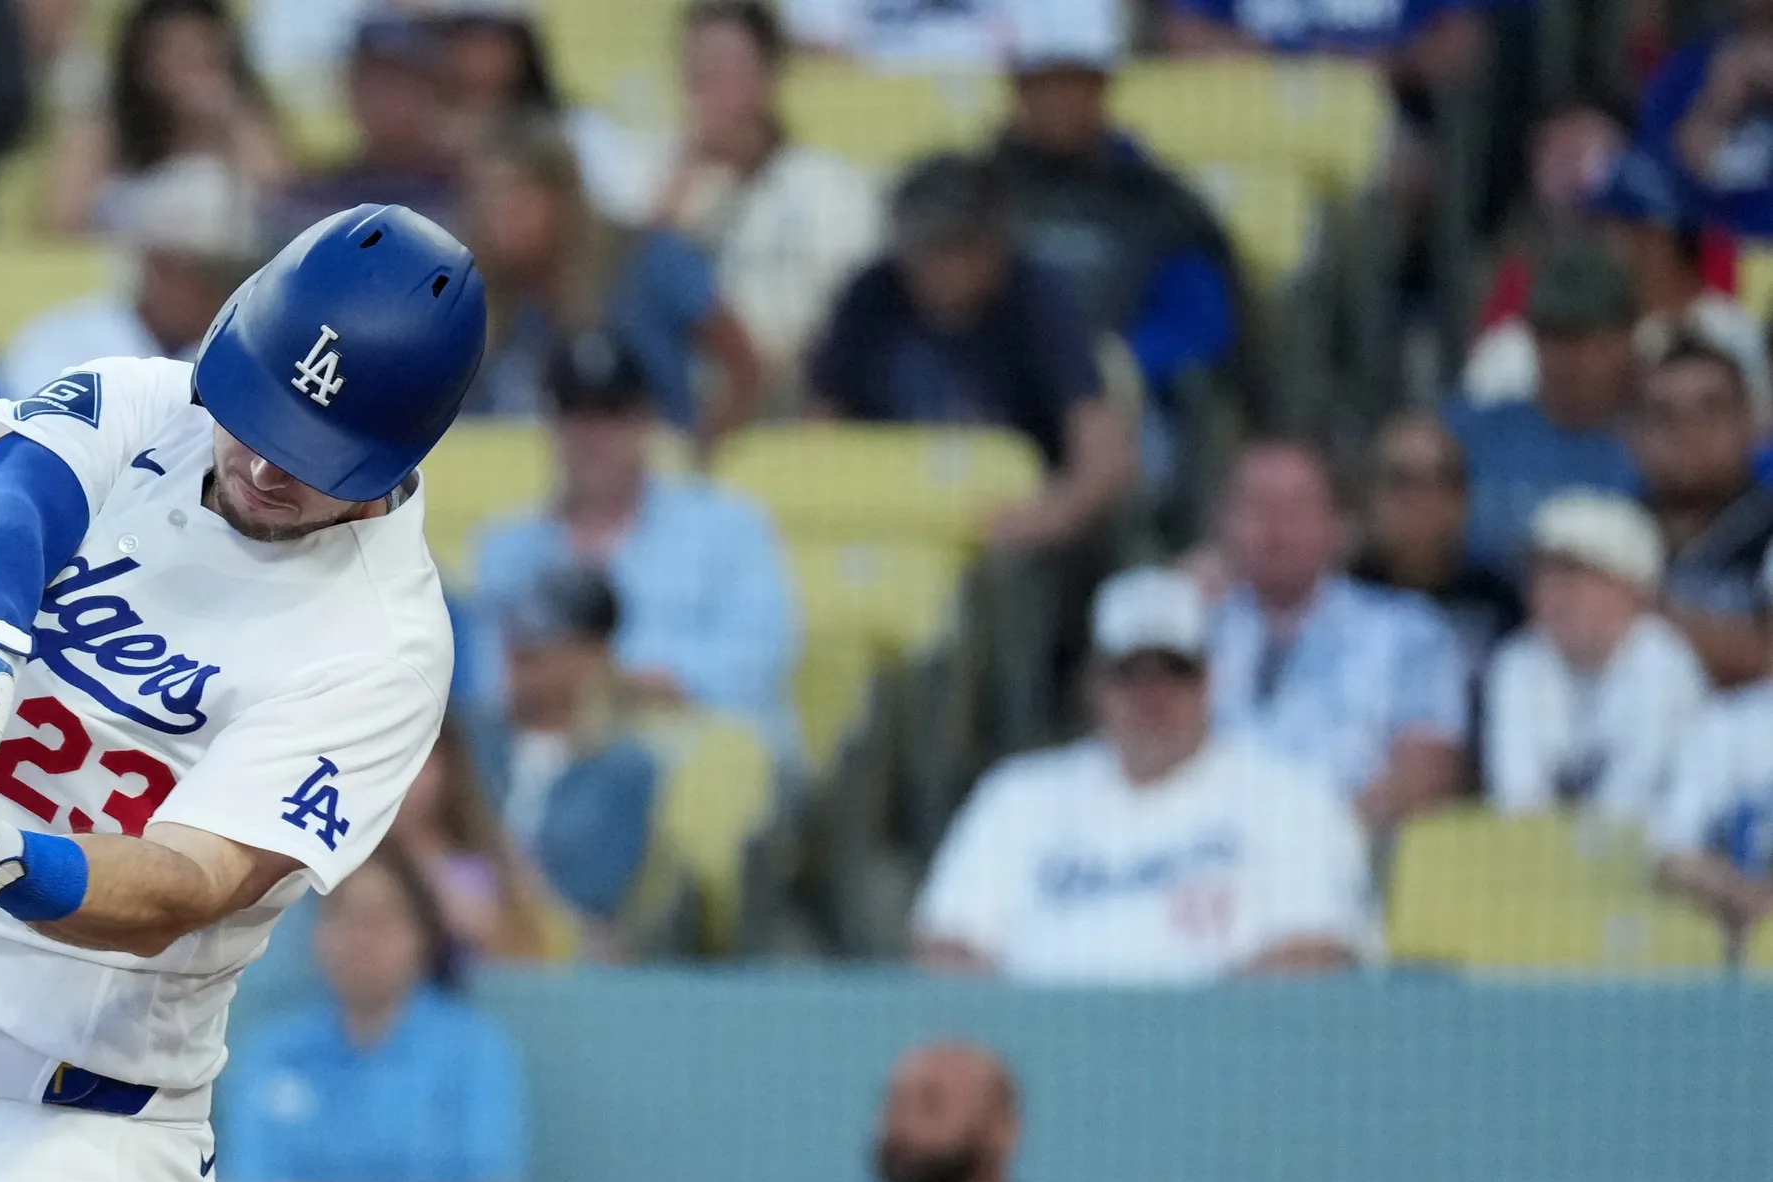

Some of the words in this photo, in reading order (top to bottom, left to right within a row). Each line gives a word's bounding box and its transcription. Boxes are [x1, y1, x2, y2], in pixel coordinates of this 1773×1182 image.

[291, 324, 344, 407] LA
[27, 556, 220, 735] dgers
[281, 755, 350, 852] LA
